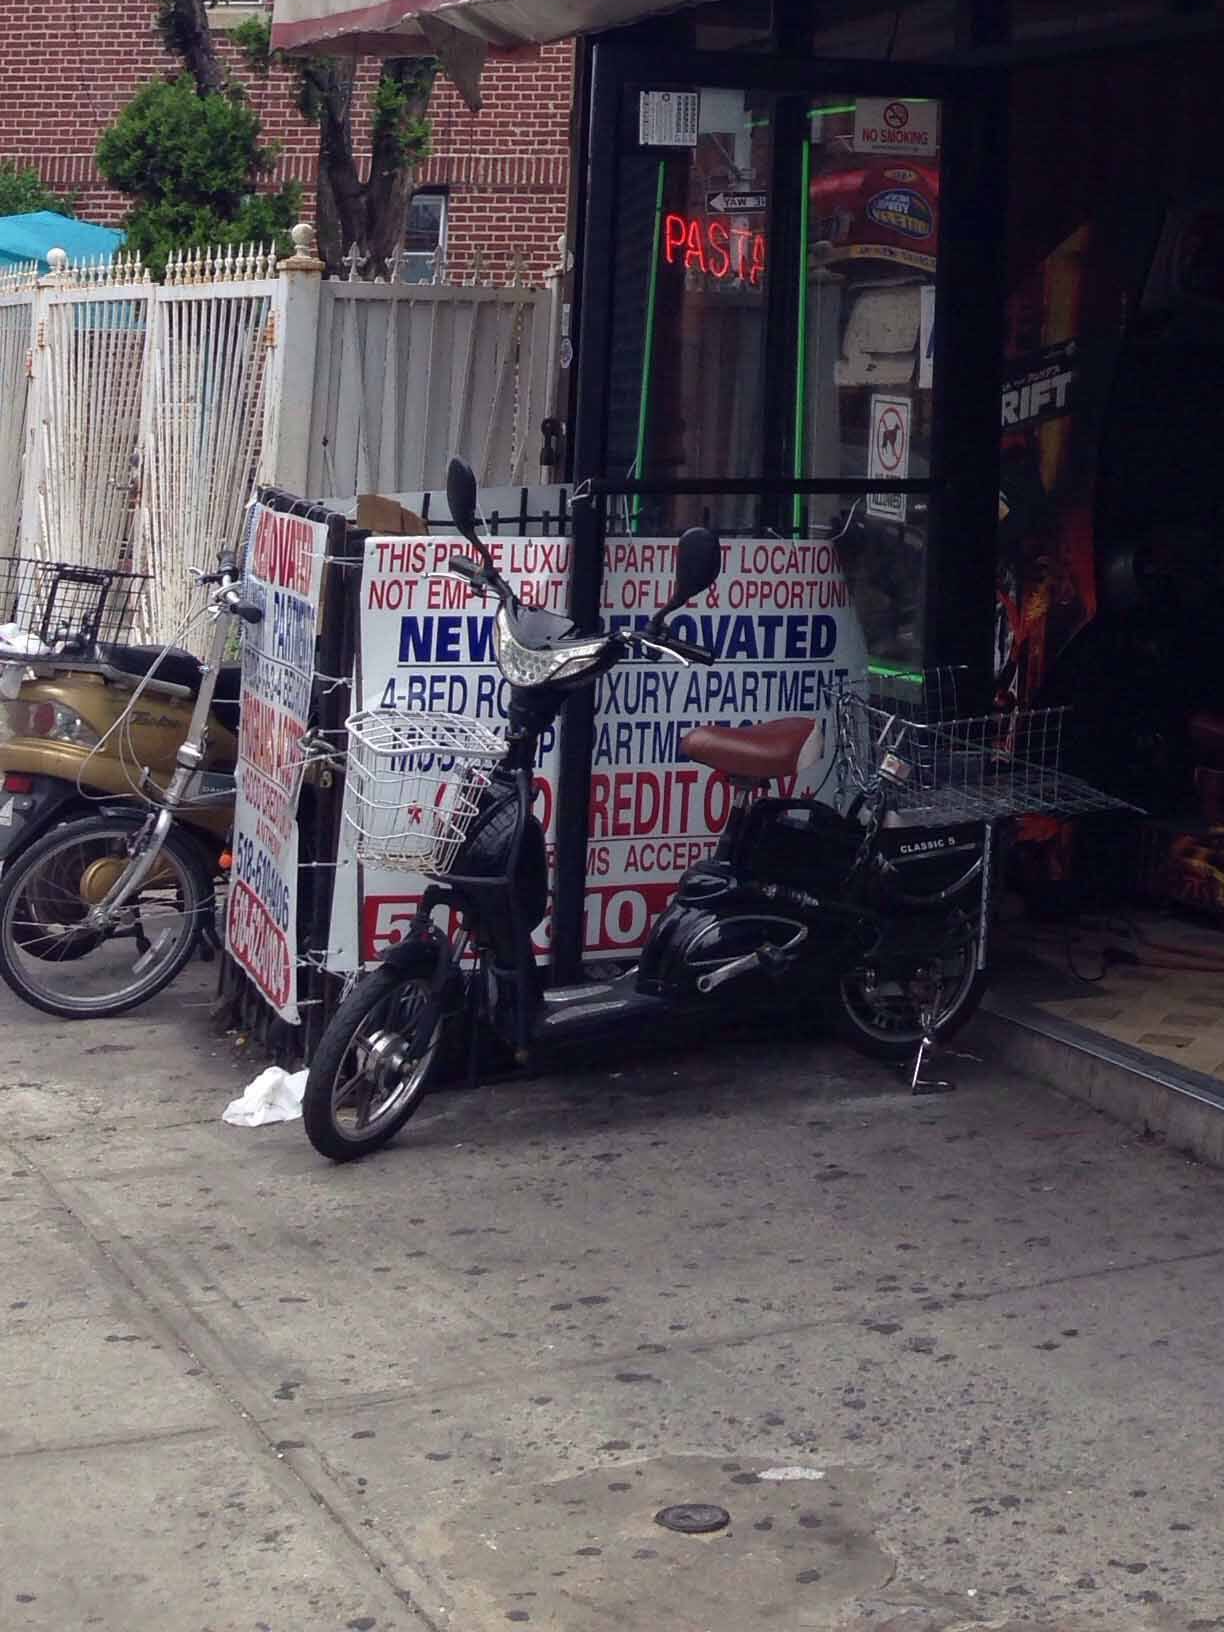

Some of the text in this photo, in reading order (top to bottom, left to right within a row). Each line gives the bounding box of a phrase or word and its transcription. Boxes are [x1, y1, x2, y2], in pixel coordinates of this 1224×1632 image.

[862, 128, 929, 145] NO SMOKING
[664, 214, 768, 286] PASTA
[376, 542, 426, 573] THIS
[510, 542, 573, 573] LUXU
[603, 544, 732, 574] APARTT
[368, 579, 420, 610] NOT
[427, 579, 506, 610] EMPT
[519, 579, 564, 609] BUT
[621, 579, 652, 609] OF
[654, 579, 699, 609] LI
[705, 581, 720, 609] &
[599, 614, 838, 661] OVATED
[380, 668, 850, 719] 4-BED RO UXURY APARTMENT
[592, 719, 731, 765] ARTME
[589, 769, 699, 839] REDIT
[900, 838, 945, 854] CLASSIC
